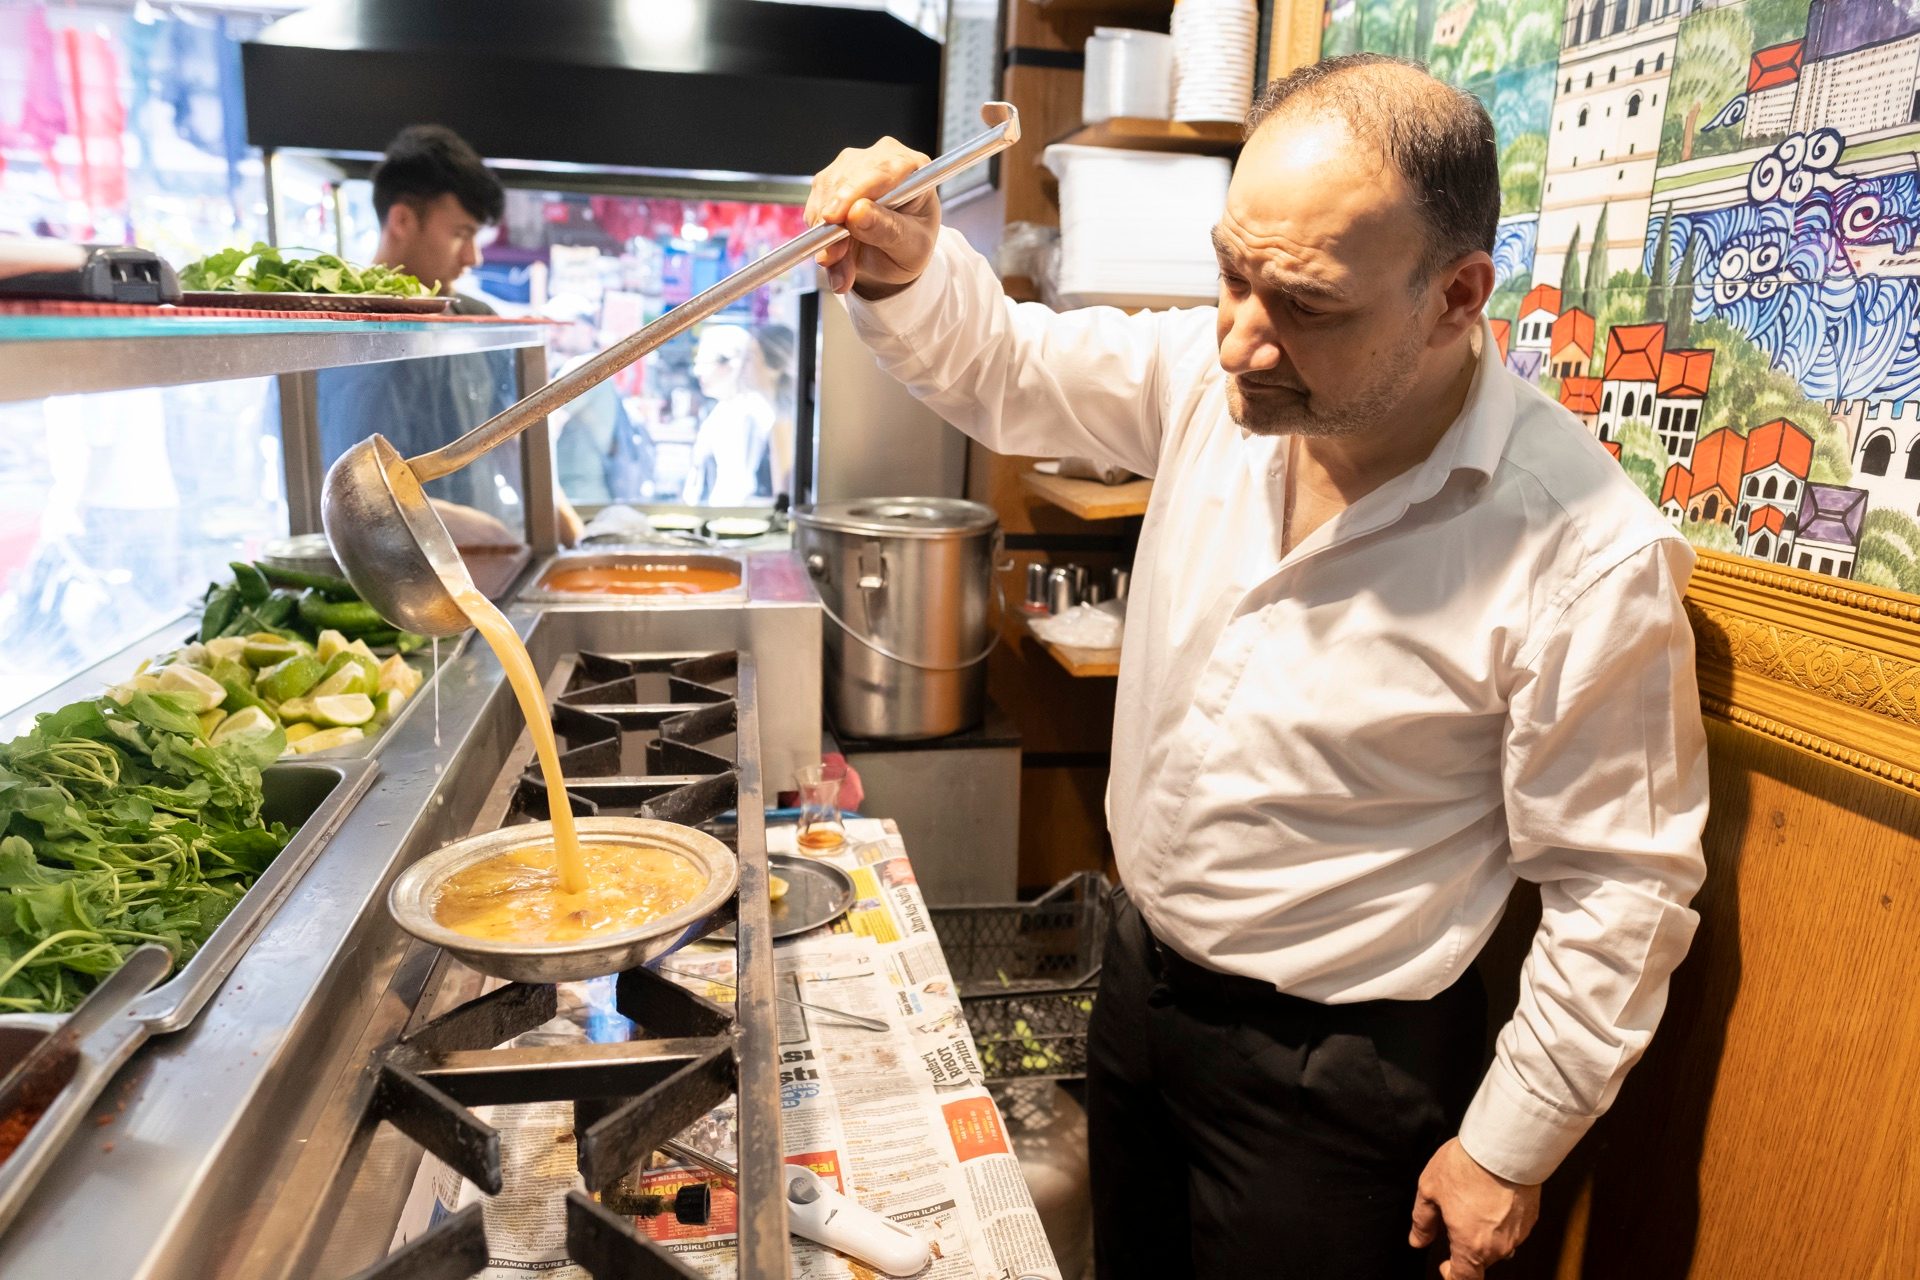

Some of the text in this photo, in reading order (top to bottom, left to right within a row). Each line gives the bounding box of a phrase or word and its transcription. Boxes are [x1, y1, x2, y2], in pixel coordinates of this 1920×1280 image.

[778, 1049, 815, 1065] sı
[807, 1161, 835, 1174] sal
[532, 1259, 563, 1270] ÇEVRE
[668, 1242, 716, 1252] EĞİŞİKLİĞİ
[921, 1204, 942, 1216] İLAN
